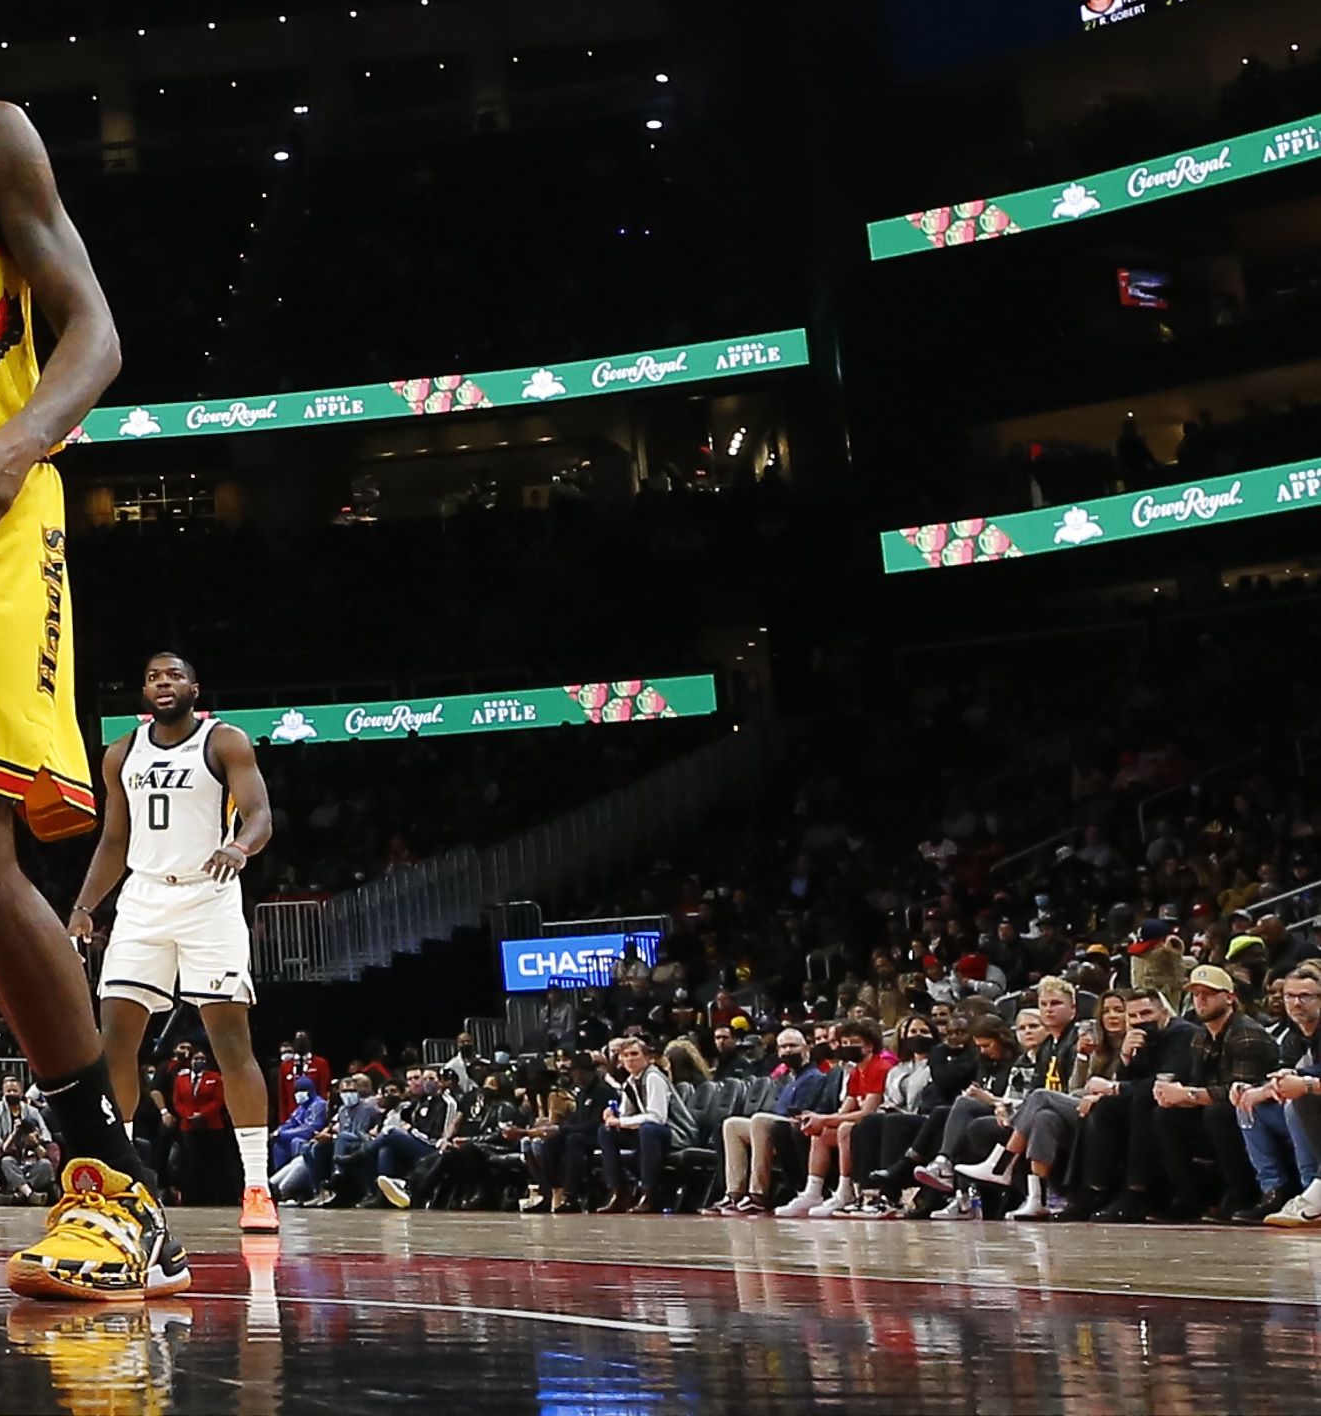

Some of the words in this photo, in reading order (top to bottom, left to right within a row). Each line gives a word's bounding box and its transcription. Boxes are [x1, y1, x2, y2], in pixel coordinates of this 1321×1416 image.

[1262, 132, 1321, 163] APPL
[715, 346, 781, 370] APPLE
[303, 399, 364, 419] APPLE
[1277, 478, 1321, 502] APP
[471, 703, 537, 725] APPLE
[128, 761, 195, 790] JAZZ
[148, 793, 170, 830] 0
